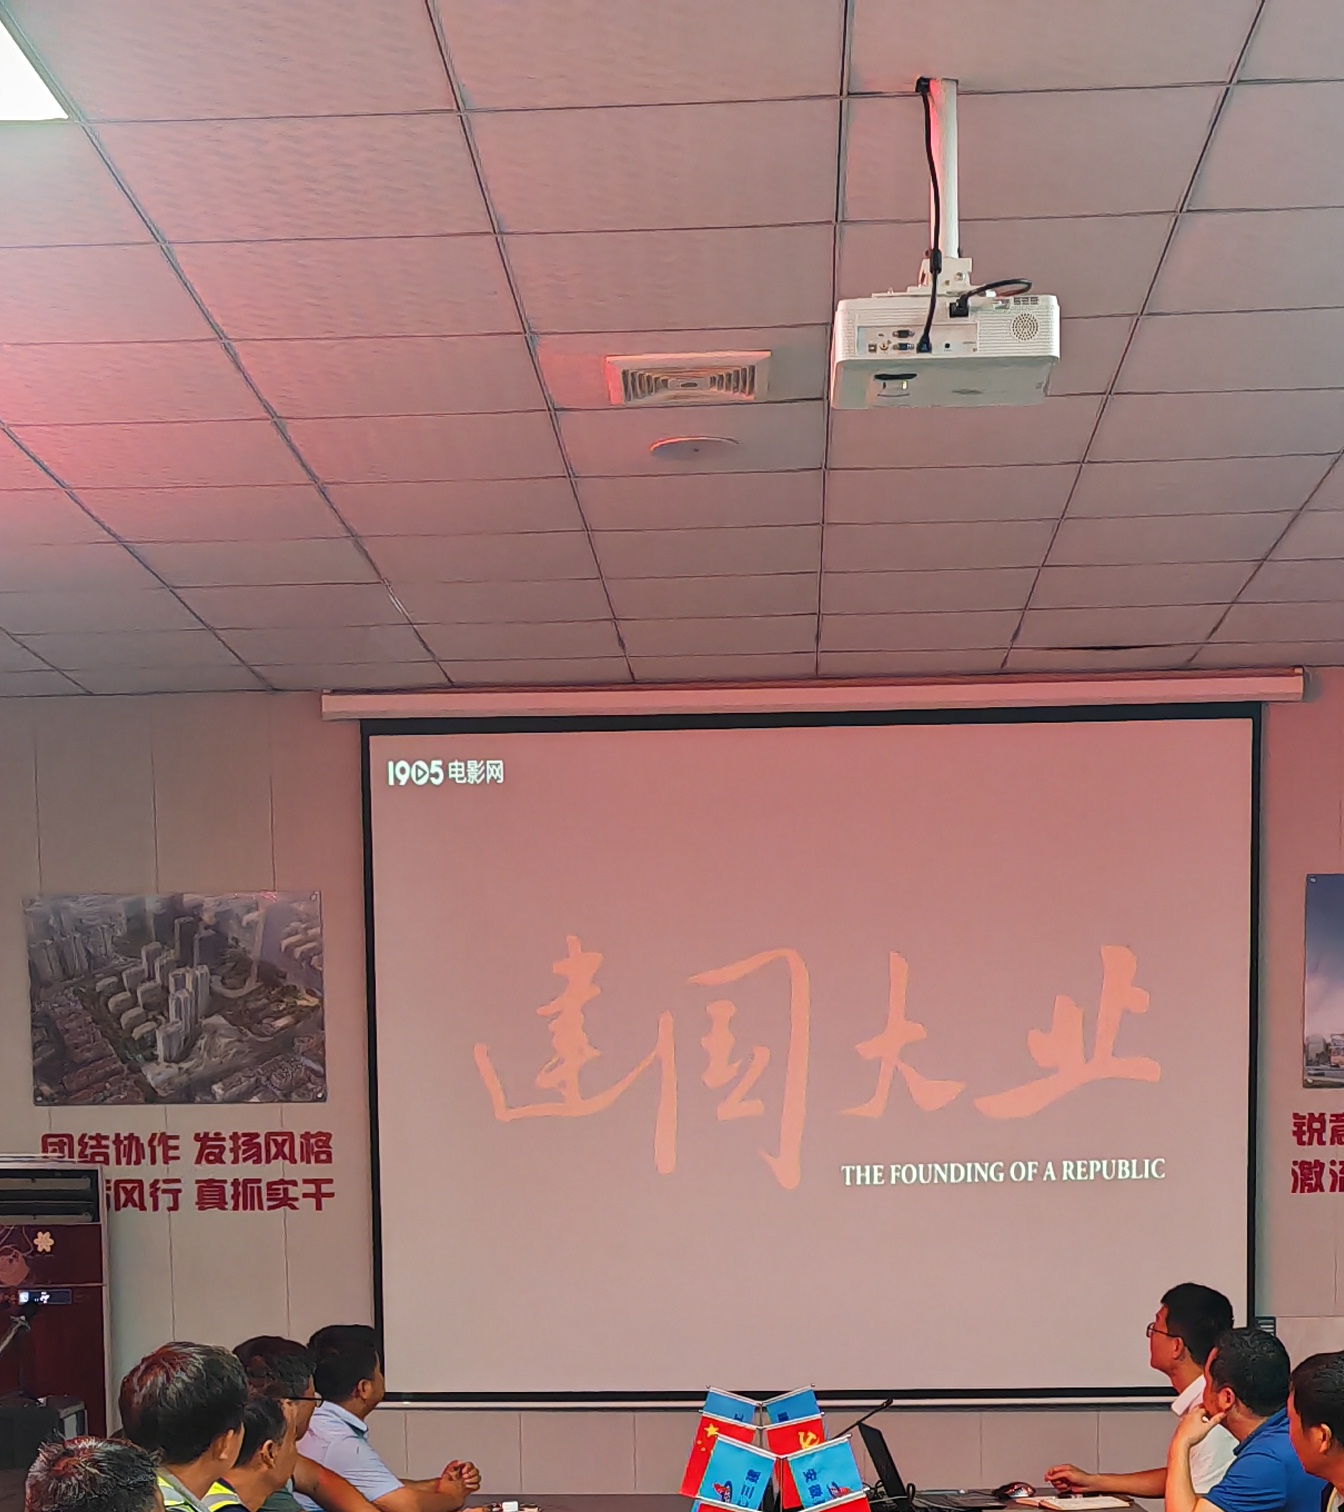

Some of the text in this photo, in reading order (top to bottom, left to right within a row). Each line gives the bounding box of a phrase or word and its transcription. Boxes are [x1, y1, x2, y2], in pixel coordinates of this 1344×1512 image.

[473, 935, 1161, 1190] 建国大业
[41, 1131, 333, 1166] 团结协作 发扬风格
[841, 1158, 1166, 1186] THE FOUNDING OF A REPUBLIC
[105, 1178, 335, 1212] 风行 真抓实干
